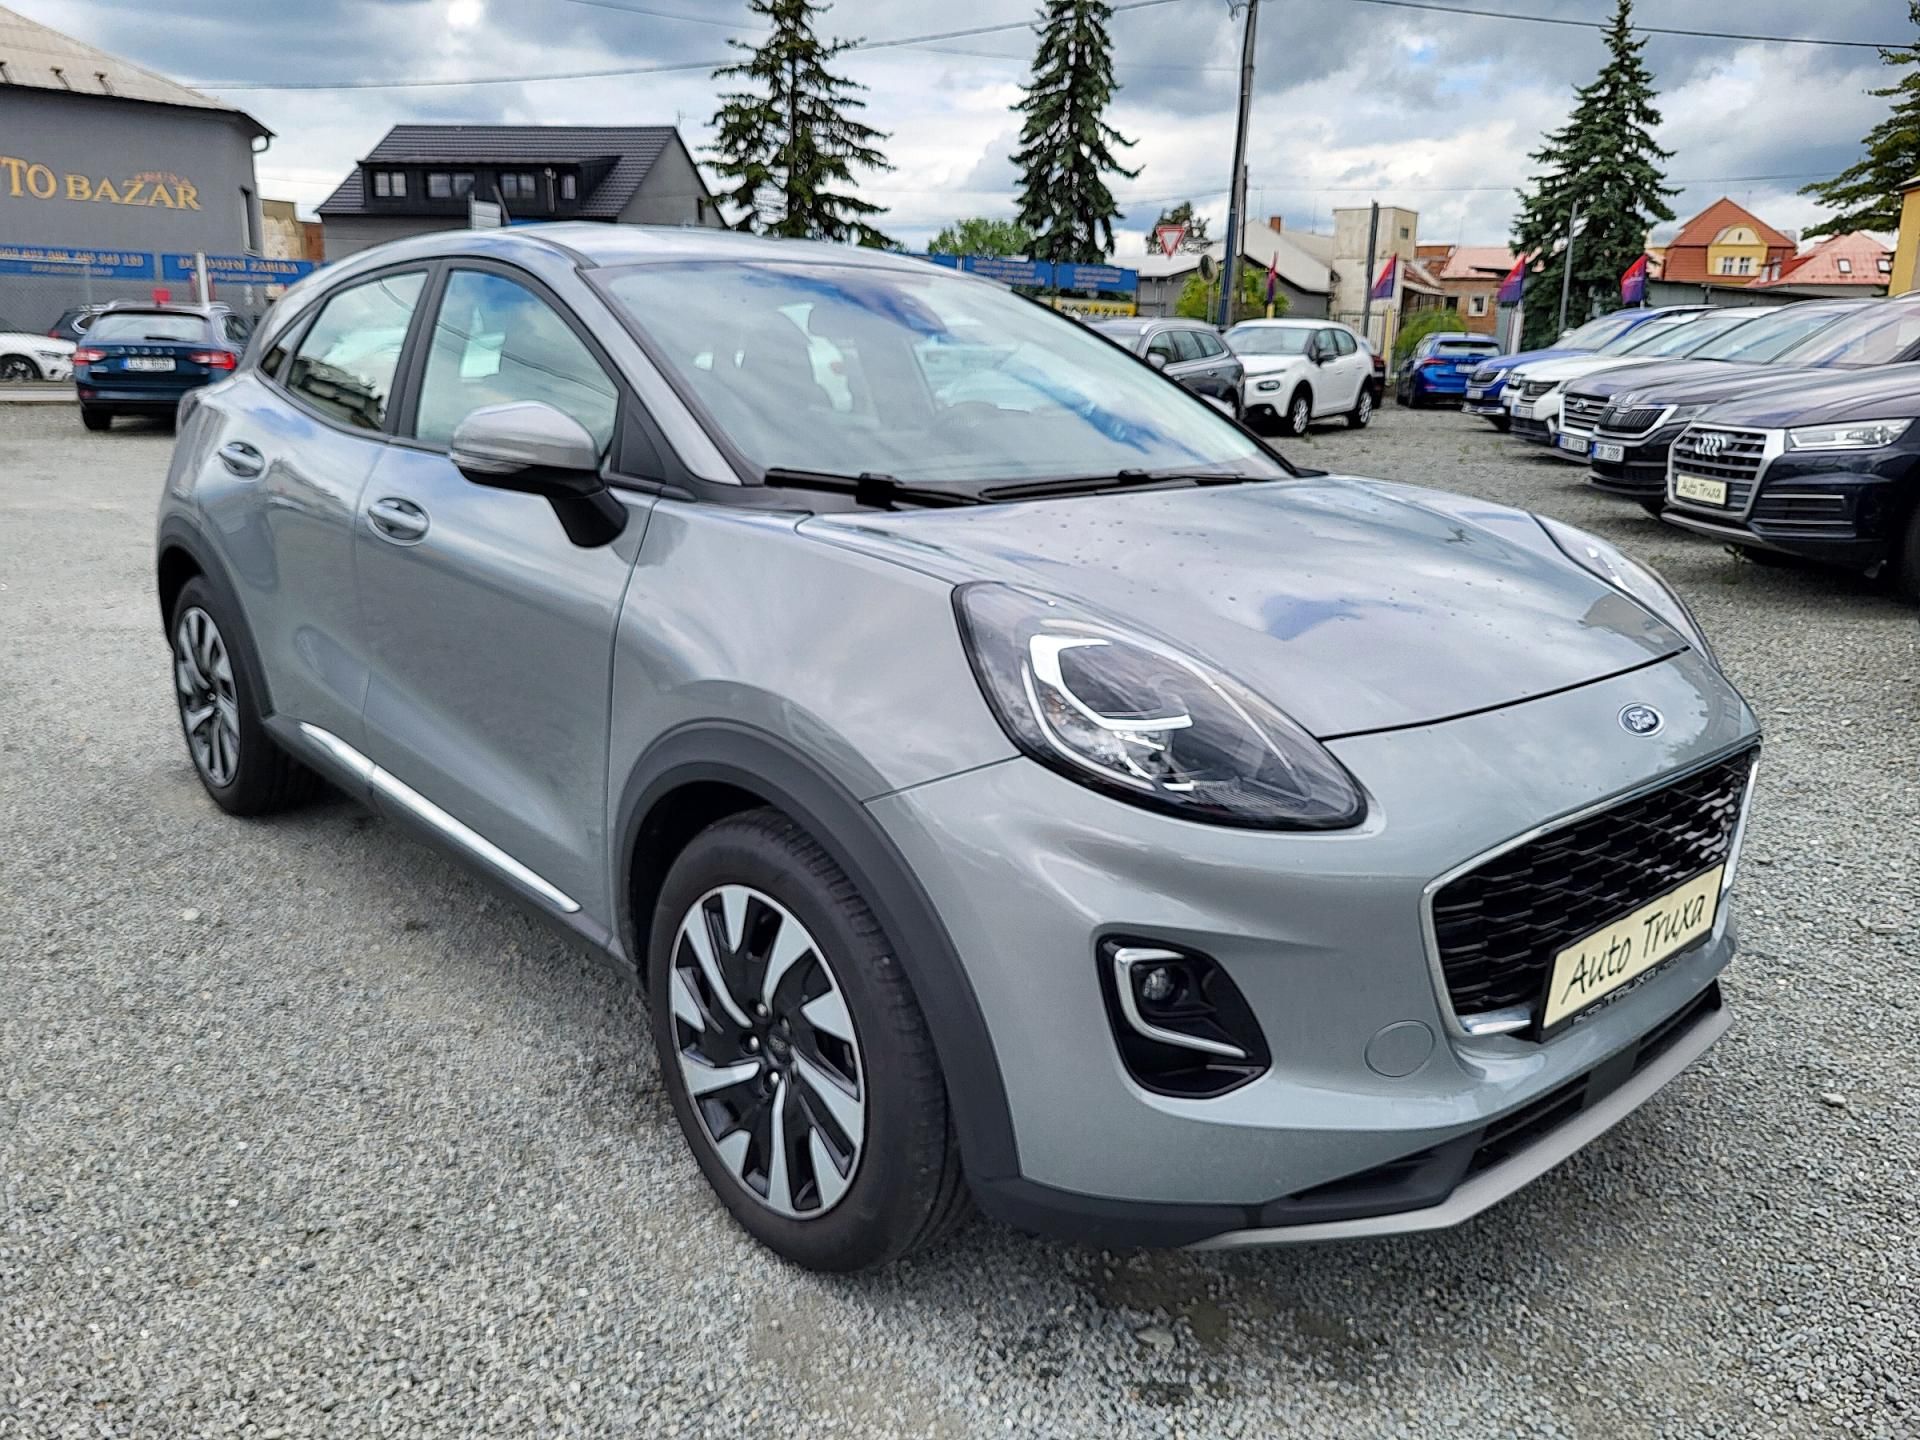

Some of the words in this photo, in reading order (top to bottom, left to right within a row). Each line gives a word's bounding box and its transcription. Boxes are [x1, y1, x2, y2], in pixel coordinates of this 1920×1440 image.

[64, 173, 201, 211] BAZAR
[1560, 935, 1632, 1005] Auto
[1643, 894, 1706, 959] Truxa
